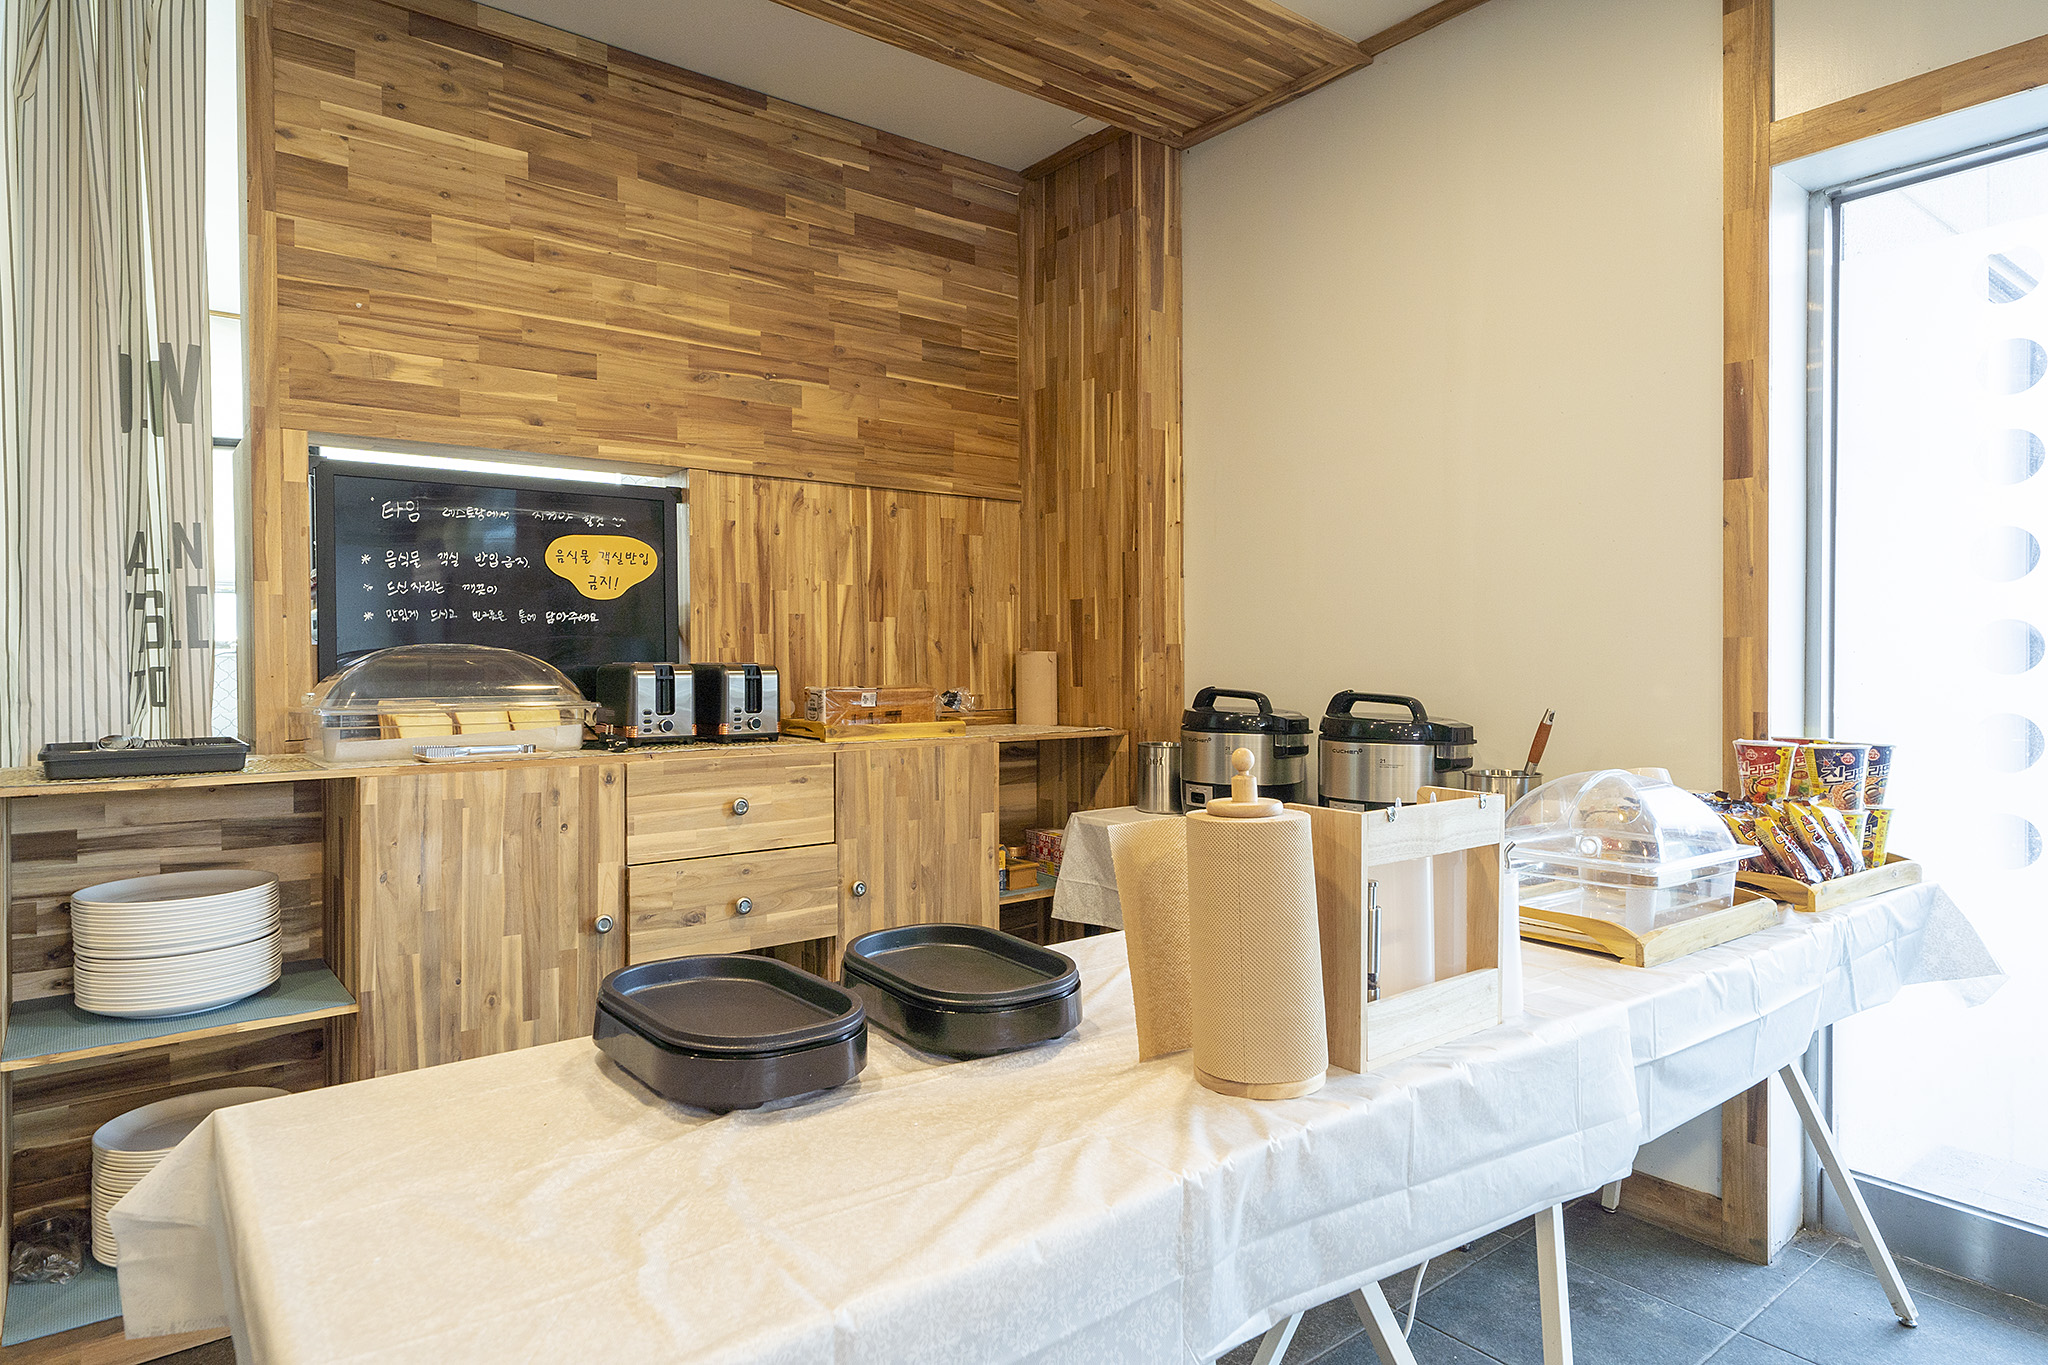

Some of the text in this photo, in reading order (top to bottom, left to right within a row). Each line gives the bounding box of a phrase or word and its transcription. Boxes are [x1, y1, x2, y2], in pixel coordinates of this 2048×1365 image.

[381, 500, 420, 523] 타임
[441, 506, 511, 522] 레스토랑에서
[384, 549, 422, 569] 음식물
[437, 551, 460, 568] 객실
[555, 549, 591, 565] 음식물
[588, 574, 619, 591] 금지!
[430, 608, 458, 623] 드시고
[518, 608, 537, 624] 통에
[545, 610, 599, 625] 담아주세요
